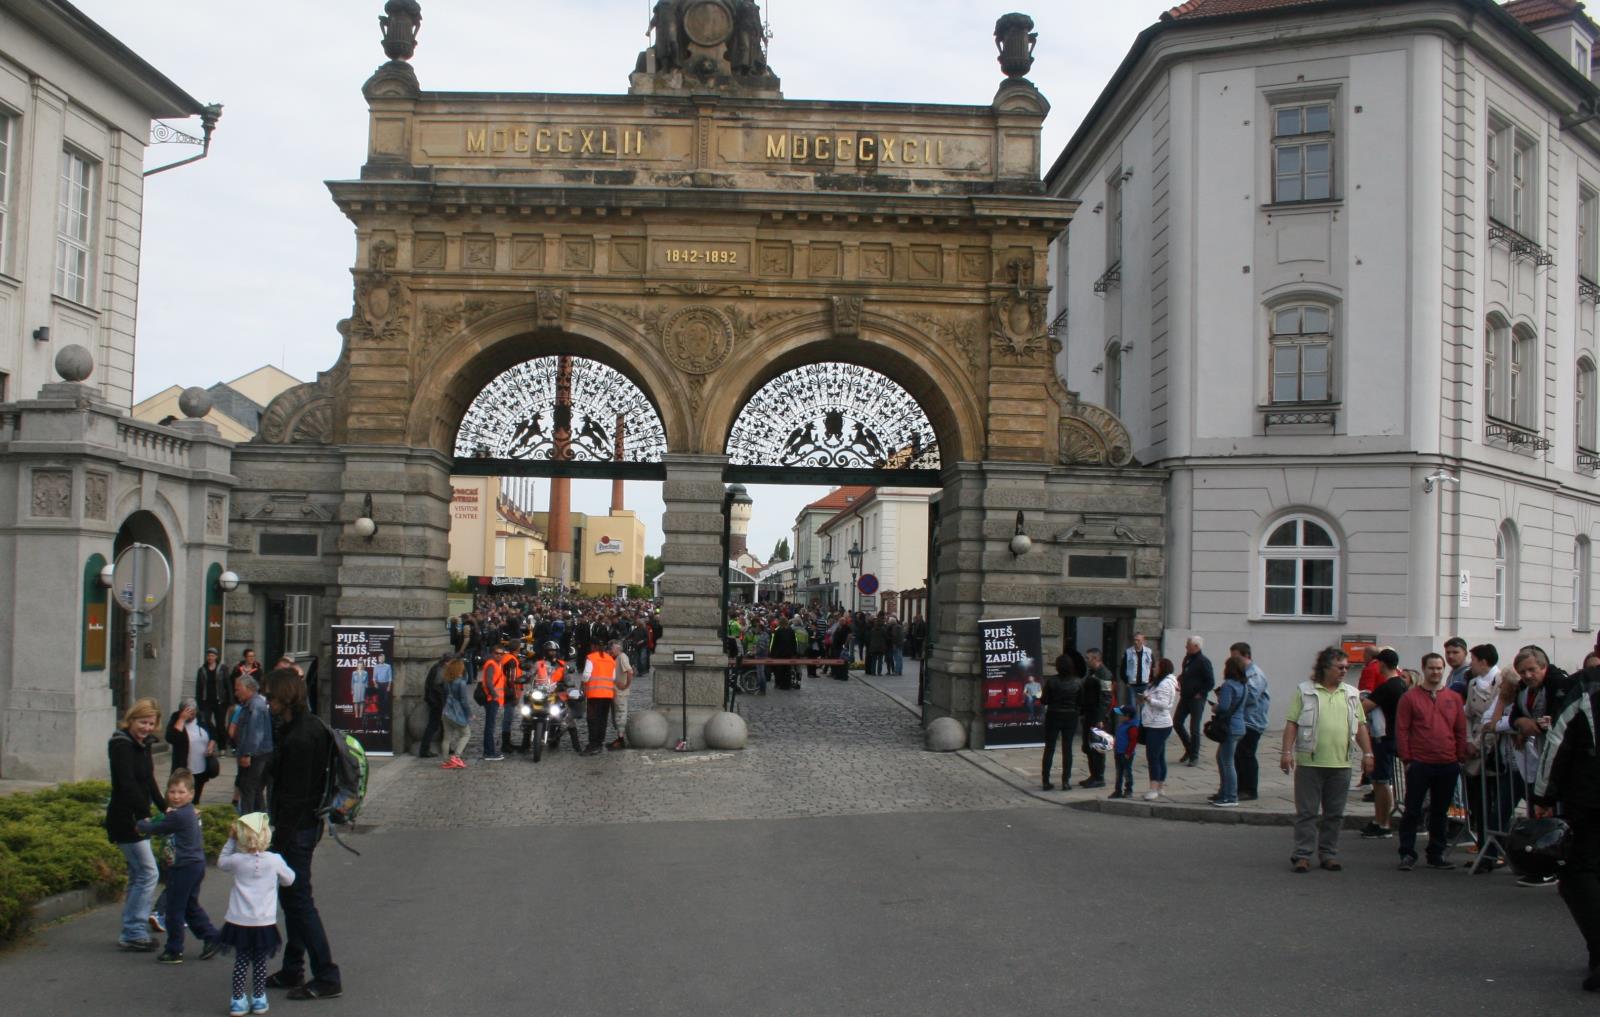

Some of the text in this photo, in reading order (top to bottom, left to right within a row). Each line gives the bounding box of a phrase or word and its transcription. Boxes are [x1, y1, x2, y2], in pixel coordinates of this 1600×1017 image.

[467, 127, 642, 155] MDCCCXLII
[766, 134, 943, 165] MDCCCXCII
[666, 249, 737, 264] 1842-1892
[336, 631, 369, 644] PIJEŠ.
[984, 625, 1016, 639] PIJEŠ.
[336, 643, 370, 655] ŘÍDÍŠ.
[984, 638, 1019, 651] ŘÍDÍŠ.
